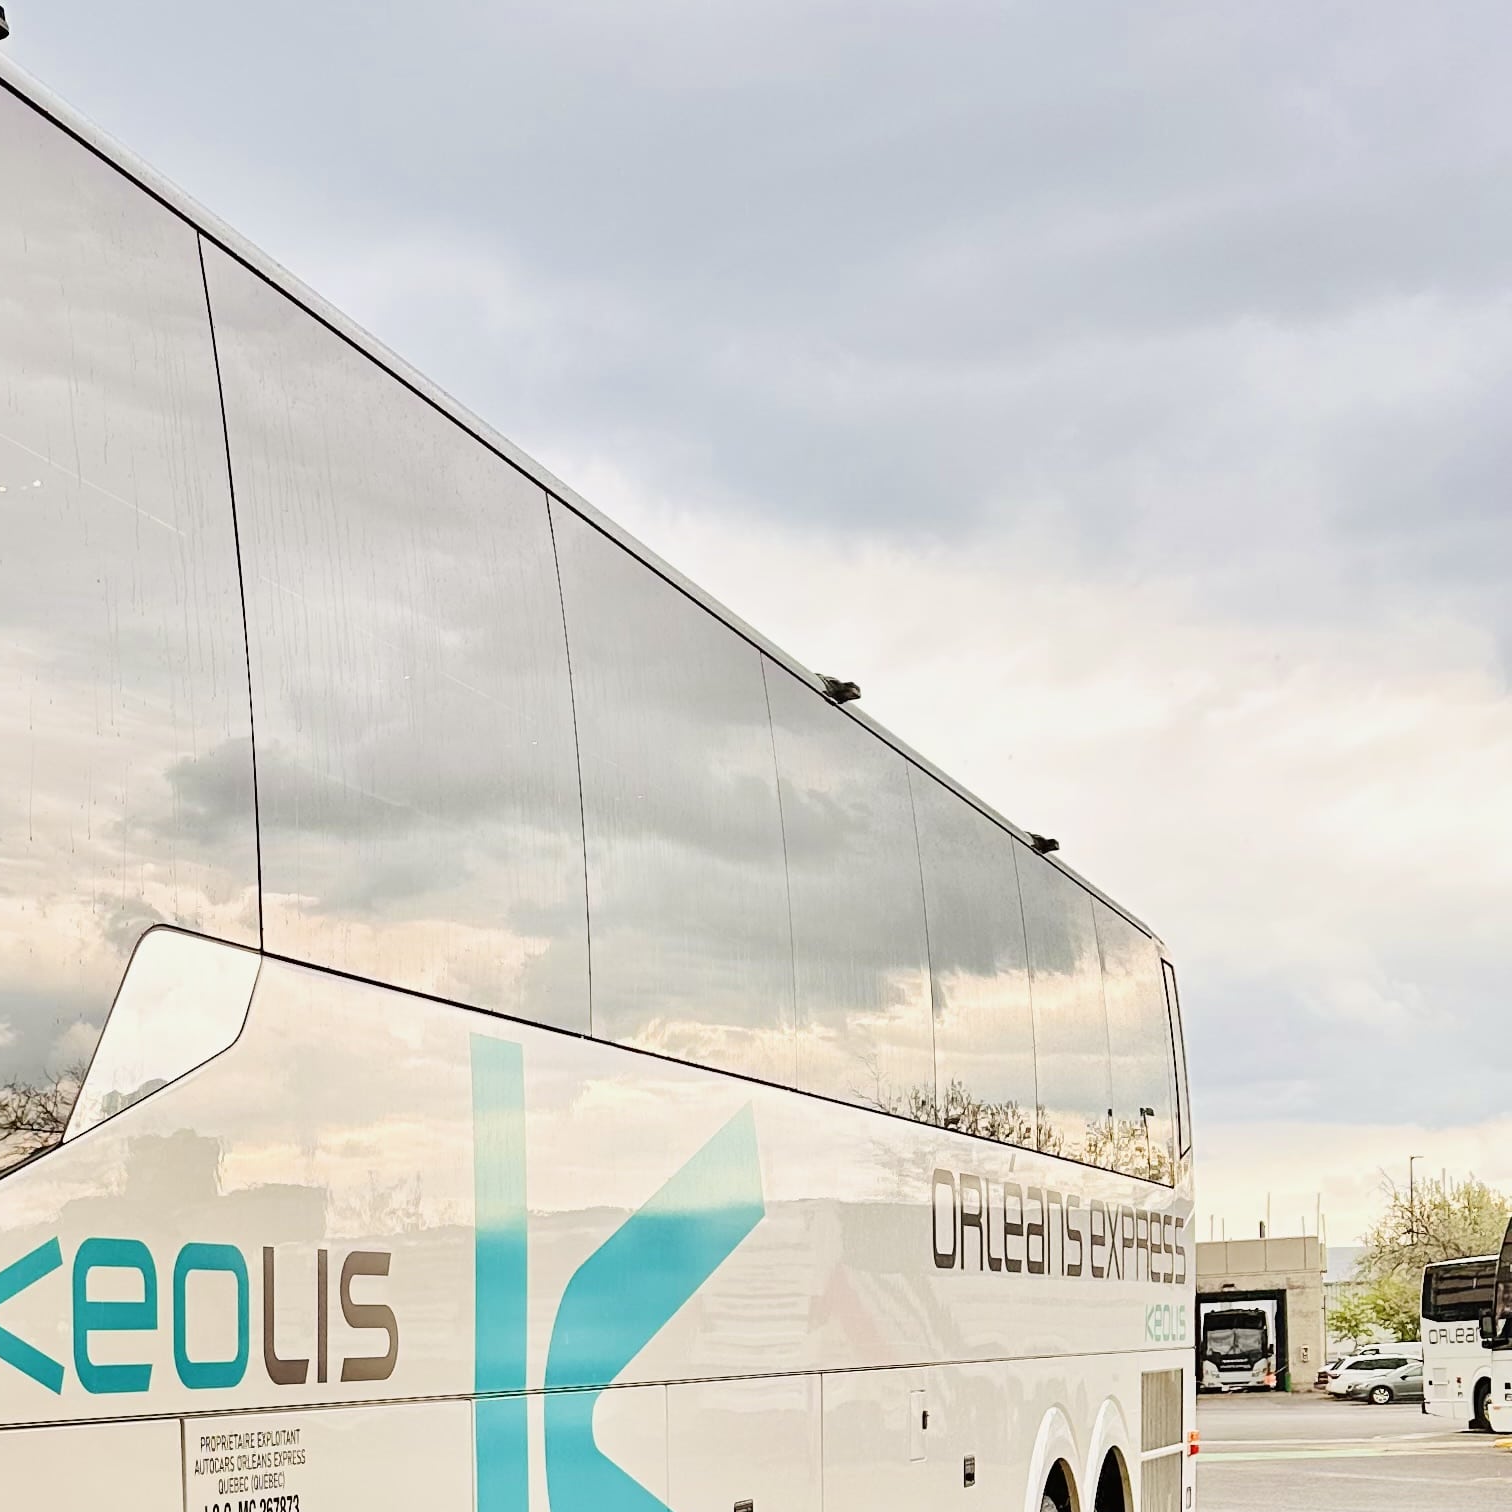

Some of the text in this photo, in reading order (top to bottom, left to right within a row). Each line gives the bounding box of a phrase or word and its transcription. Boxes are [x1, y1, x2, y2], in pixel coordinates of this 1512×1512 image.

[257, 1428, 300, 1448] EXPLOITANT
[194, 1456, 234, 1476] AUTOCARS
[274, 1448, 306, 1468] EXPRESS
